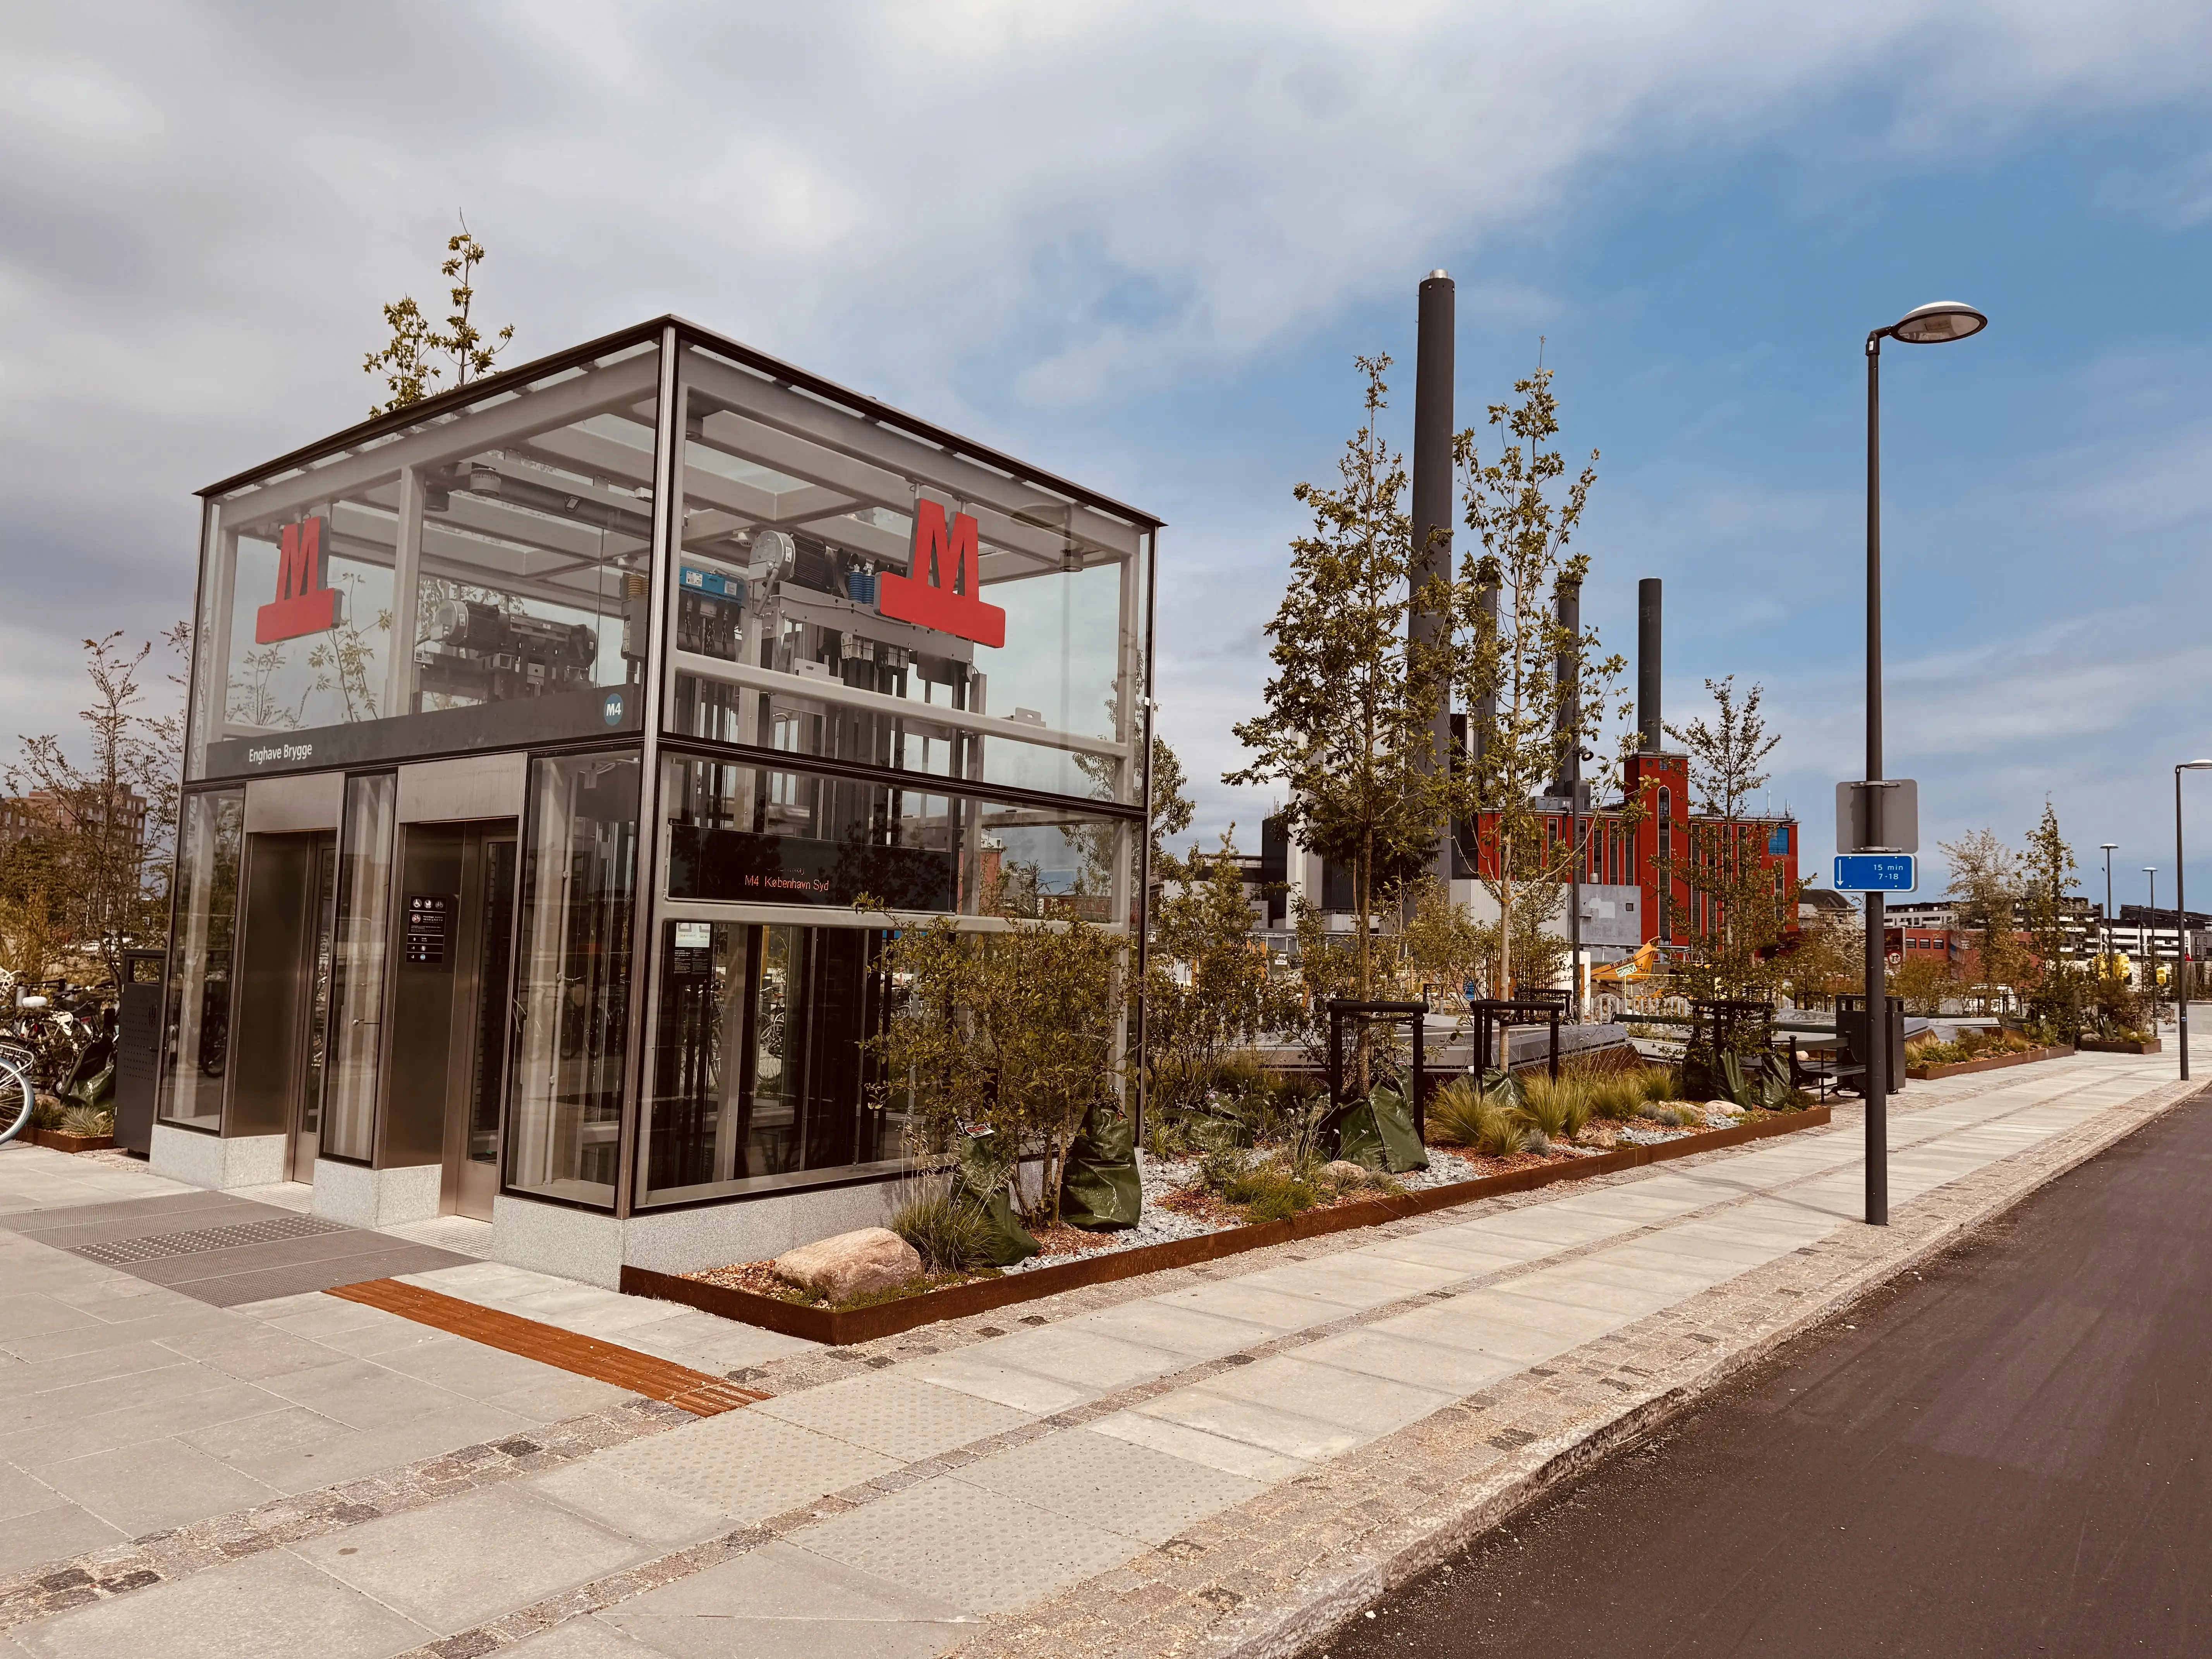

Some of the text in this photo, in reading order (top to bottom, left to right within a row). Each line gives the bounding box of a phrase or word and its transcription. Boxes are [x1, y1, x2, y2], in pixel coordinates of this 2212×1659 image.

[606, 702, 622, 716] M4
[249, 744, 313, 765] Enghave Brygge
[745, 875, 829, 892] M4 København Syd
